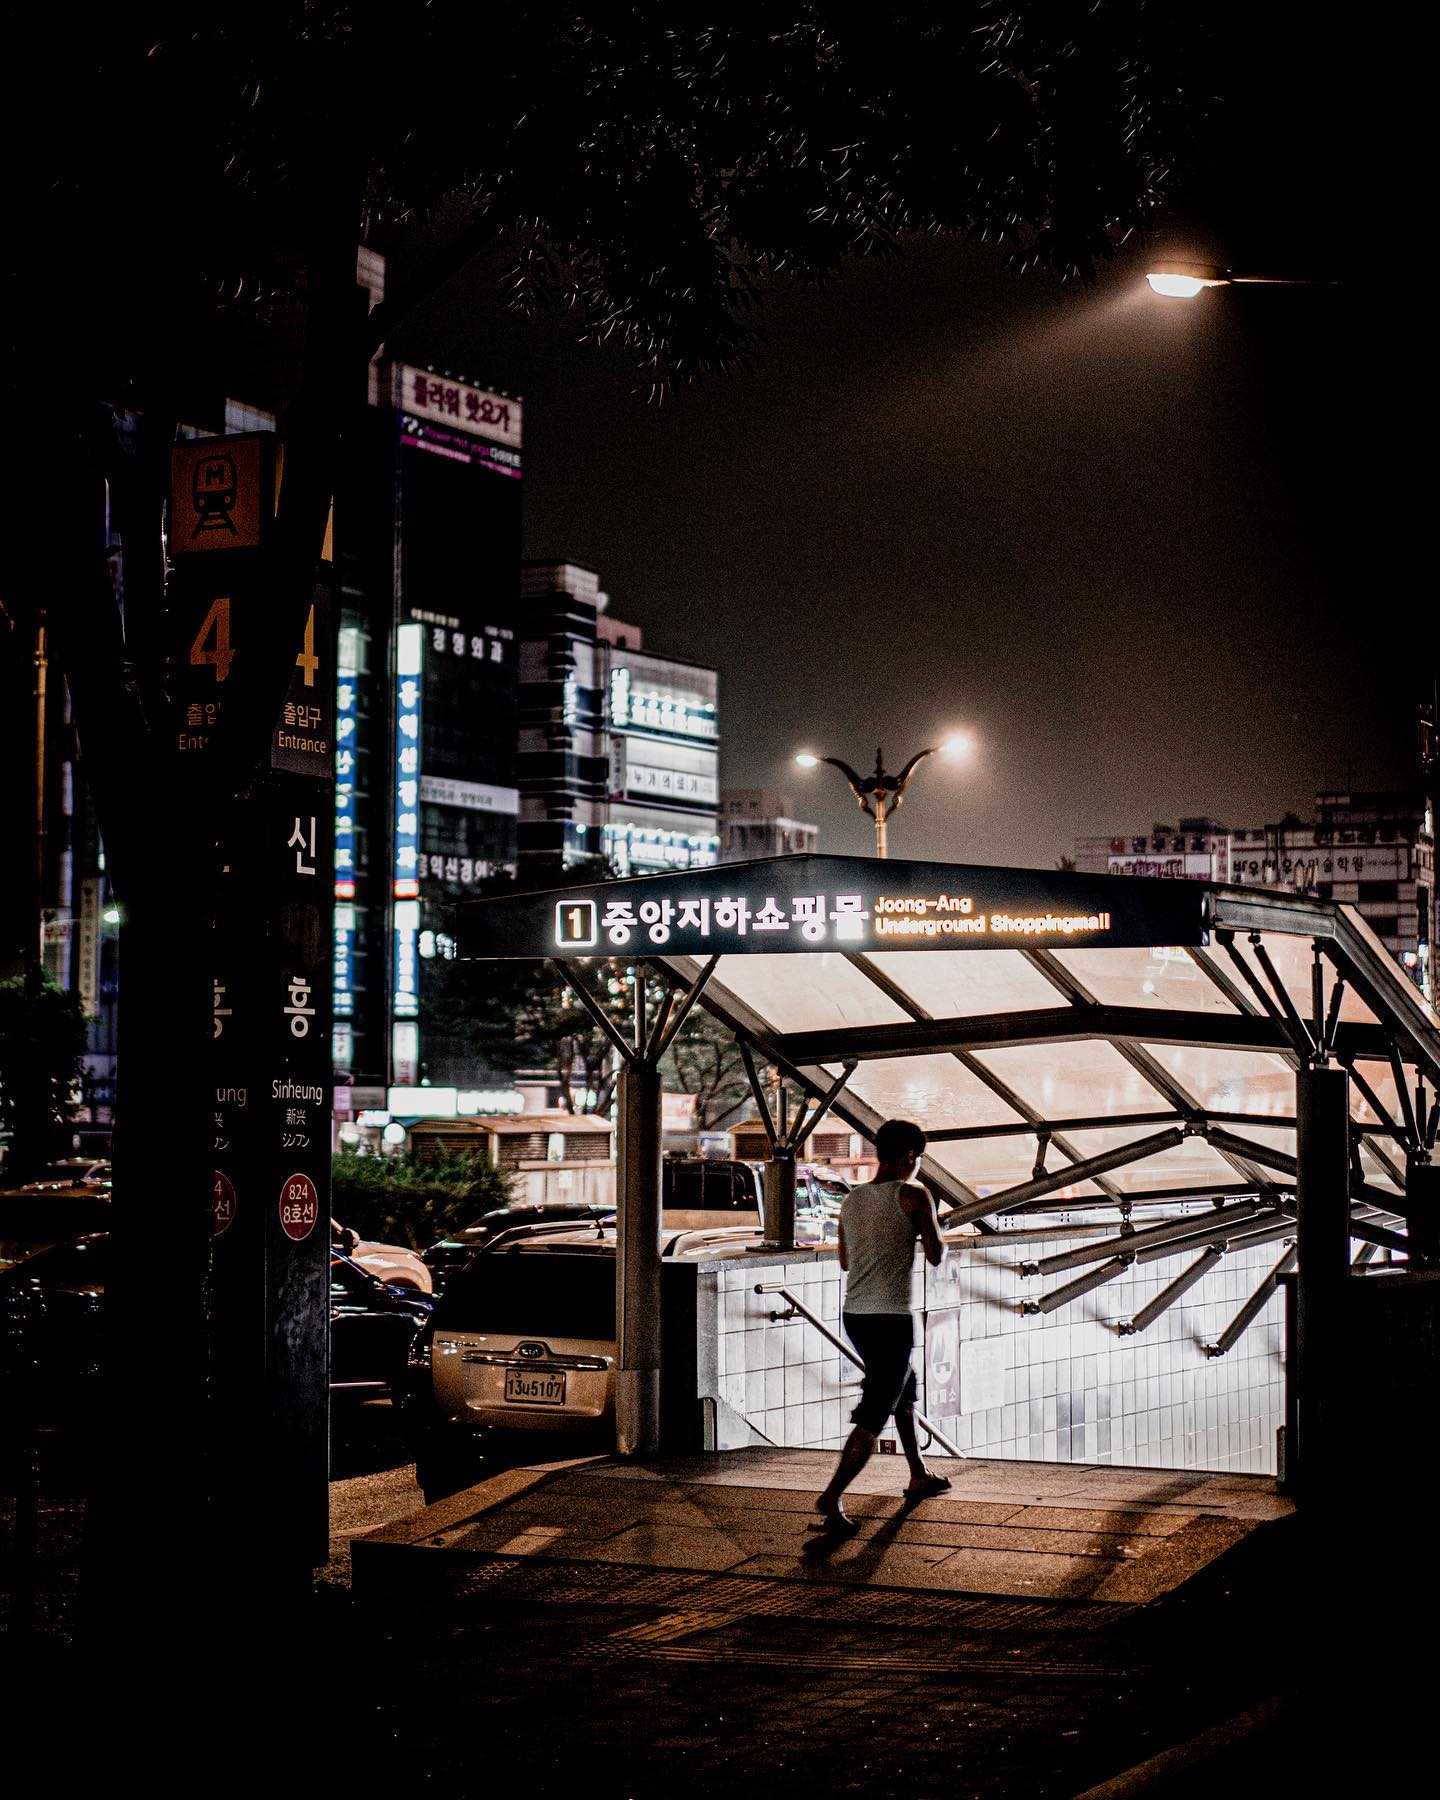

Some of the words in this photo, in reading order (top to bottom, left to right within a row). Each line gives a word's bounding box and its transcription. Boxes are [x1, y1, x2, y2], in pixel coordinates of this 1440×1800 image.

[190, 597, 235, 682] 4
[296, 604, 319, 687] 4
[283, 701, 322, 729] 출입구
[278, 730, 327, 754] Entrance
[875, 895, 972, 915] Joong-Ang
[601, 895, 869, 944] 중앙지하쇼핑몰
[875, 915, 986, 937] Underground
[990, 911, 1111, 937] Shoppingmall
[271, 1078, 323, 1106] Sinheung
[289, 1183, 309, 1200] 824
[283, 1202, 314, 1224] 8호선
